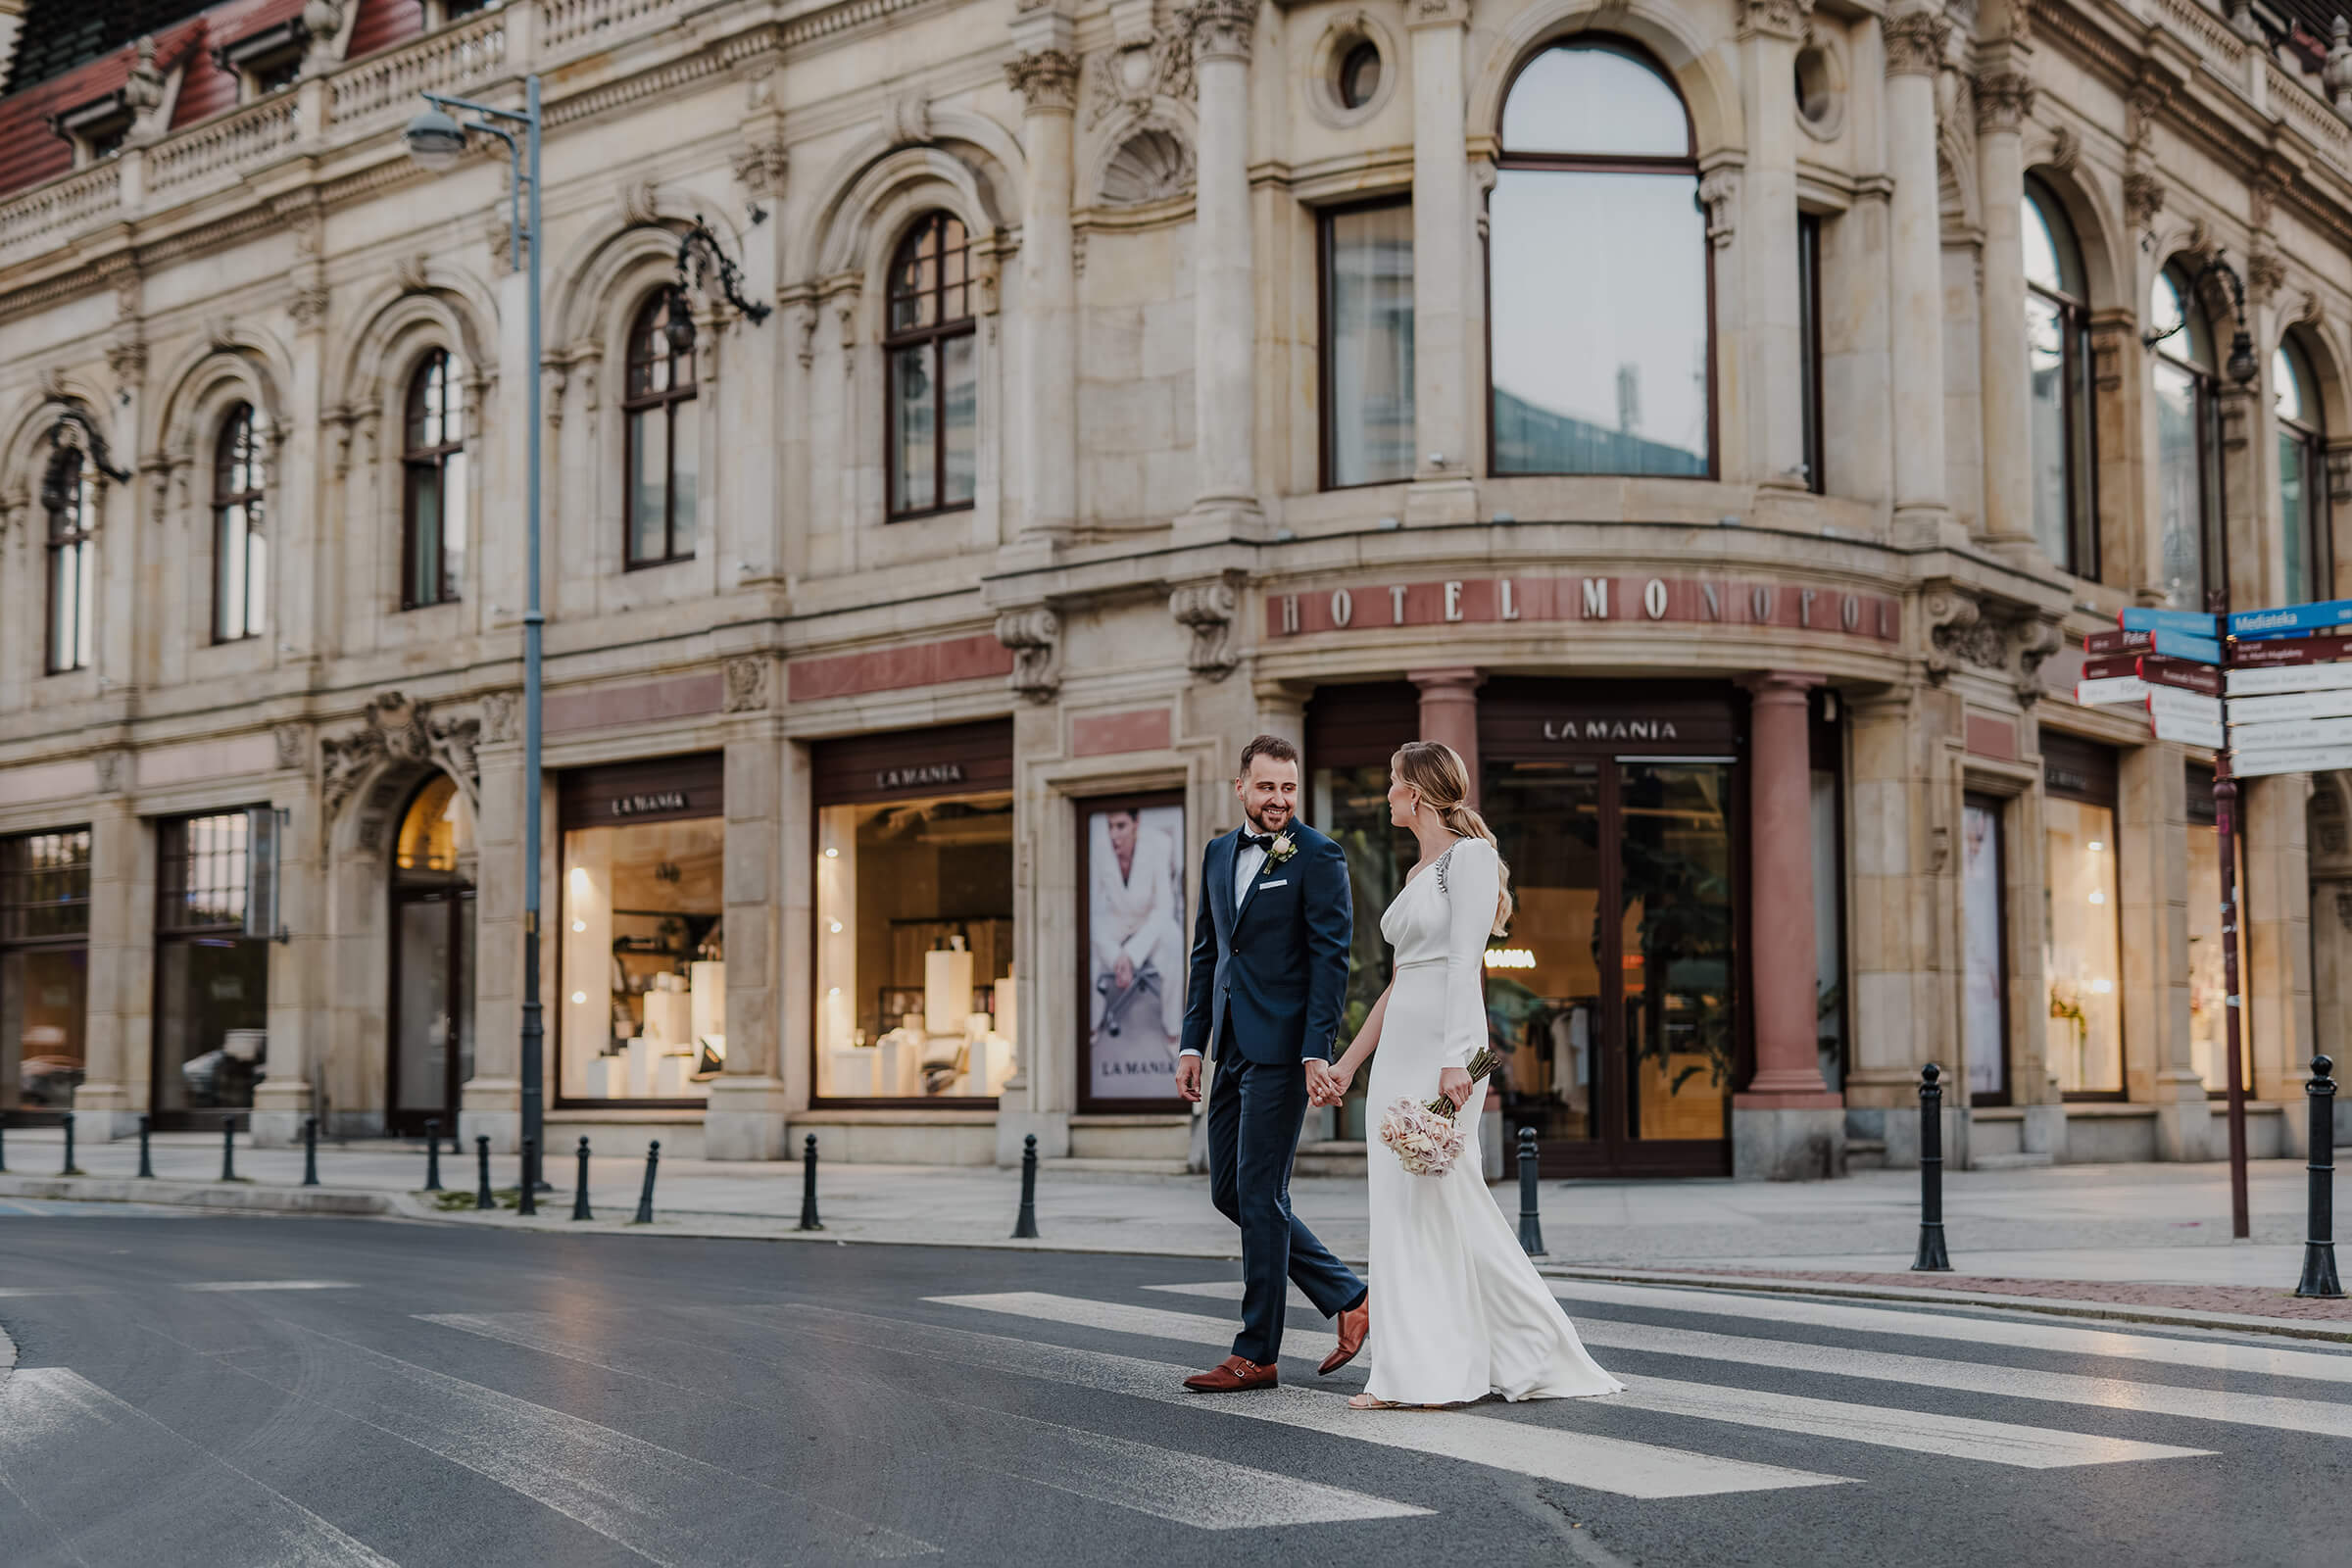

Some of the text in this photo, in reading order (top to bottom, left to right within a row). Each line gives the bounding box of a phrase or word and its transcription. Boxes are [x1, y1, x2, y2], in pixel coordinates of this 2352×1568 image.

[1282, 577, 1889, 637] HOTEL MONOPOL
[2235, 612, 2298, 632] Mediateka
[1544, 720, 1678, 740] LA MANIA
[1101, 1060, 1122, 1077] LA
